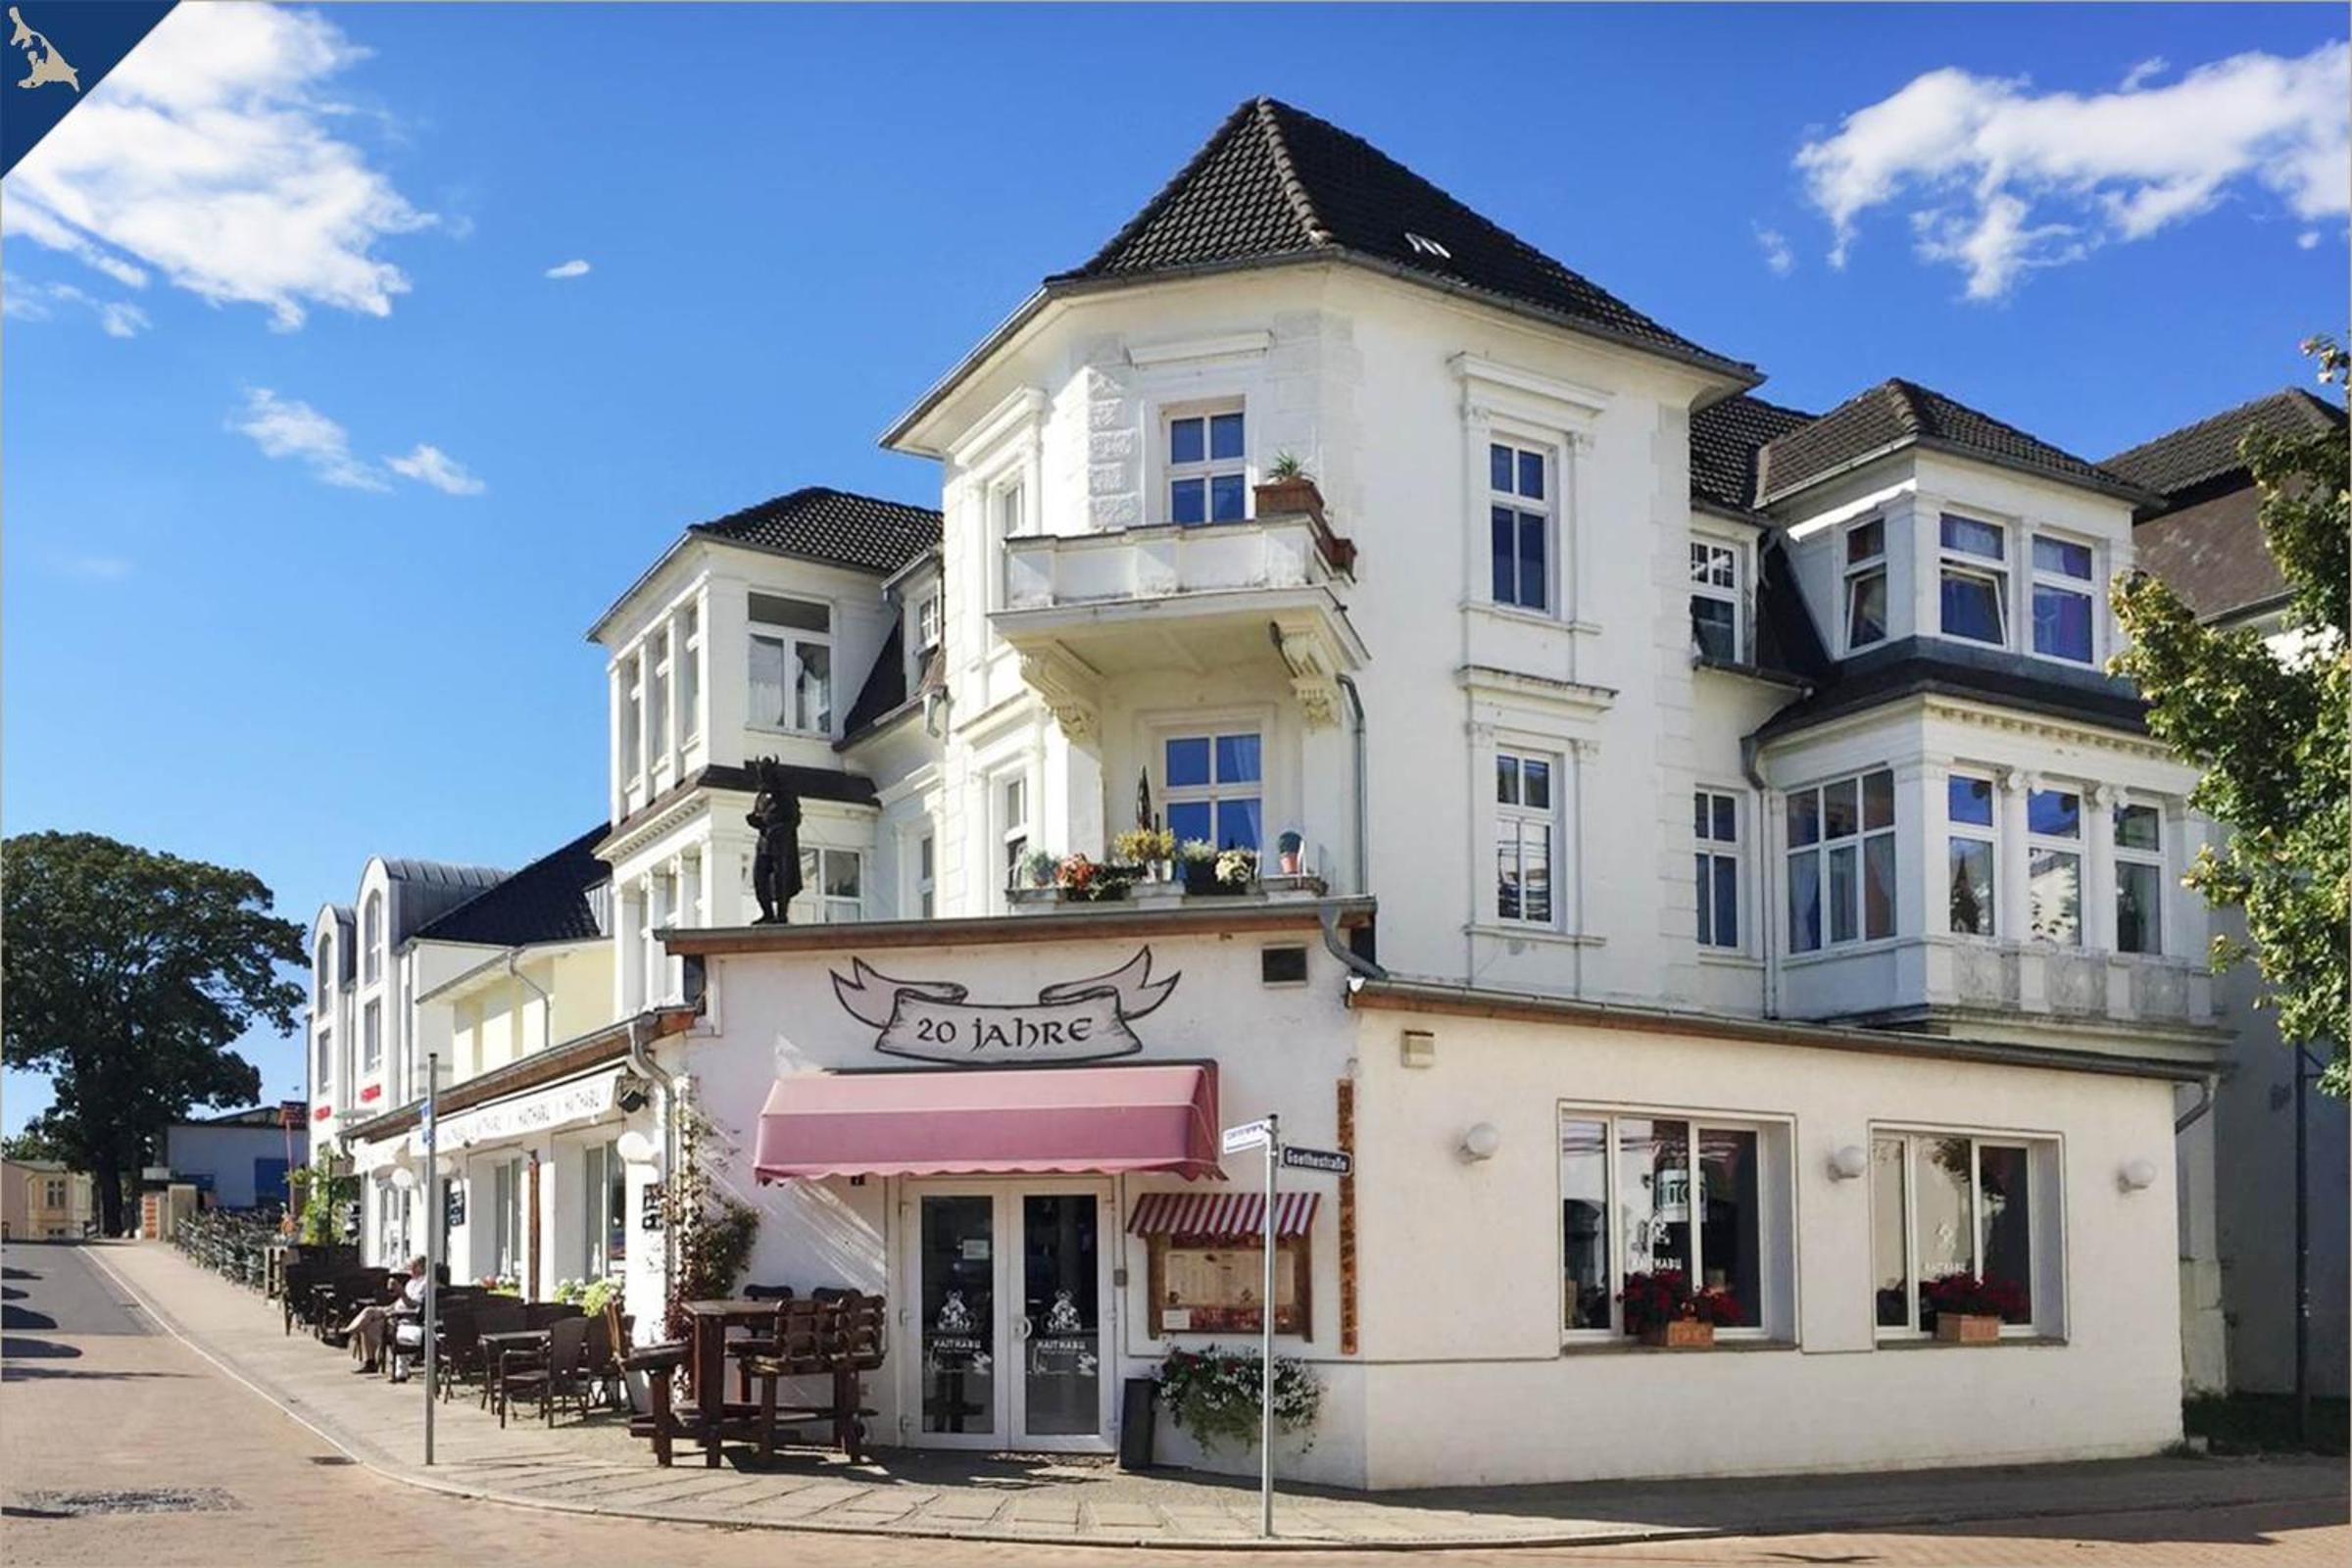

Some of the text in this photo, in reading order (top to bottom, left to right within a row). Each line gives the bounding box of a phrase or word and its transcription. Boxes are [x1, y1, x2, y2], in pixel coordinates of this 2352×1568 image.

[917, 1017, 1093, 1052] 20 JAHRE
[1287, 1150, 1347, 1171] Goethestraße
